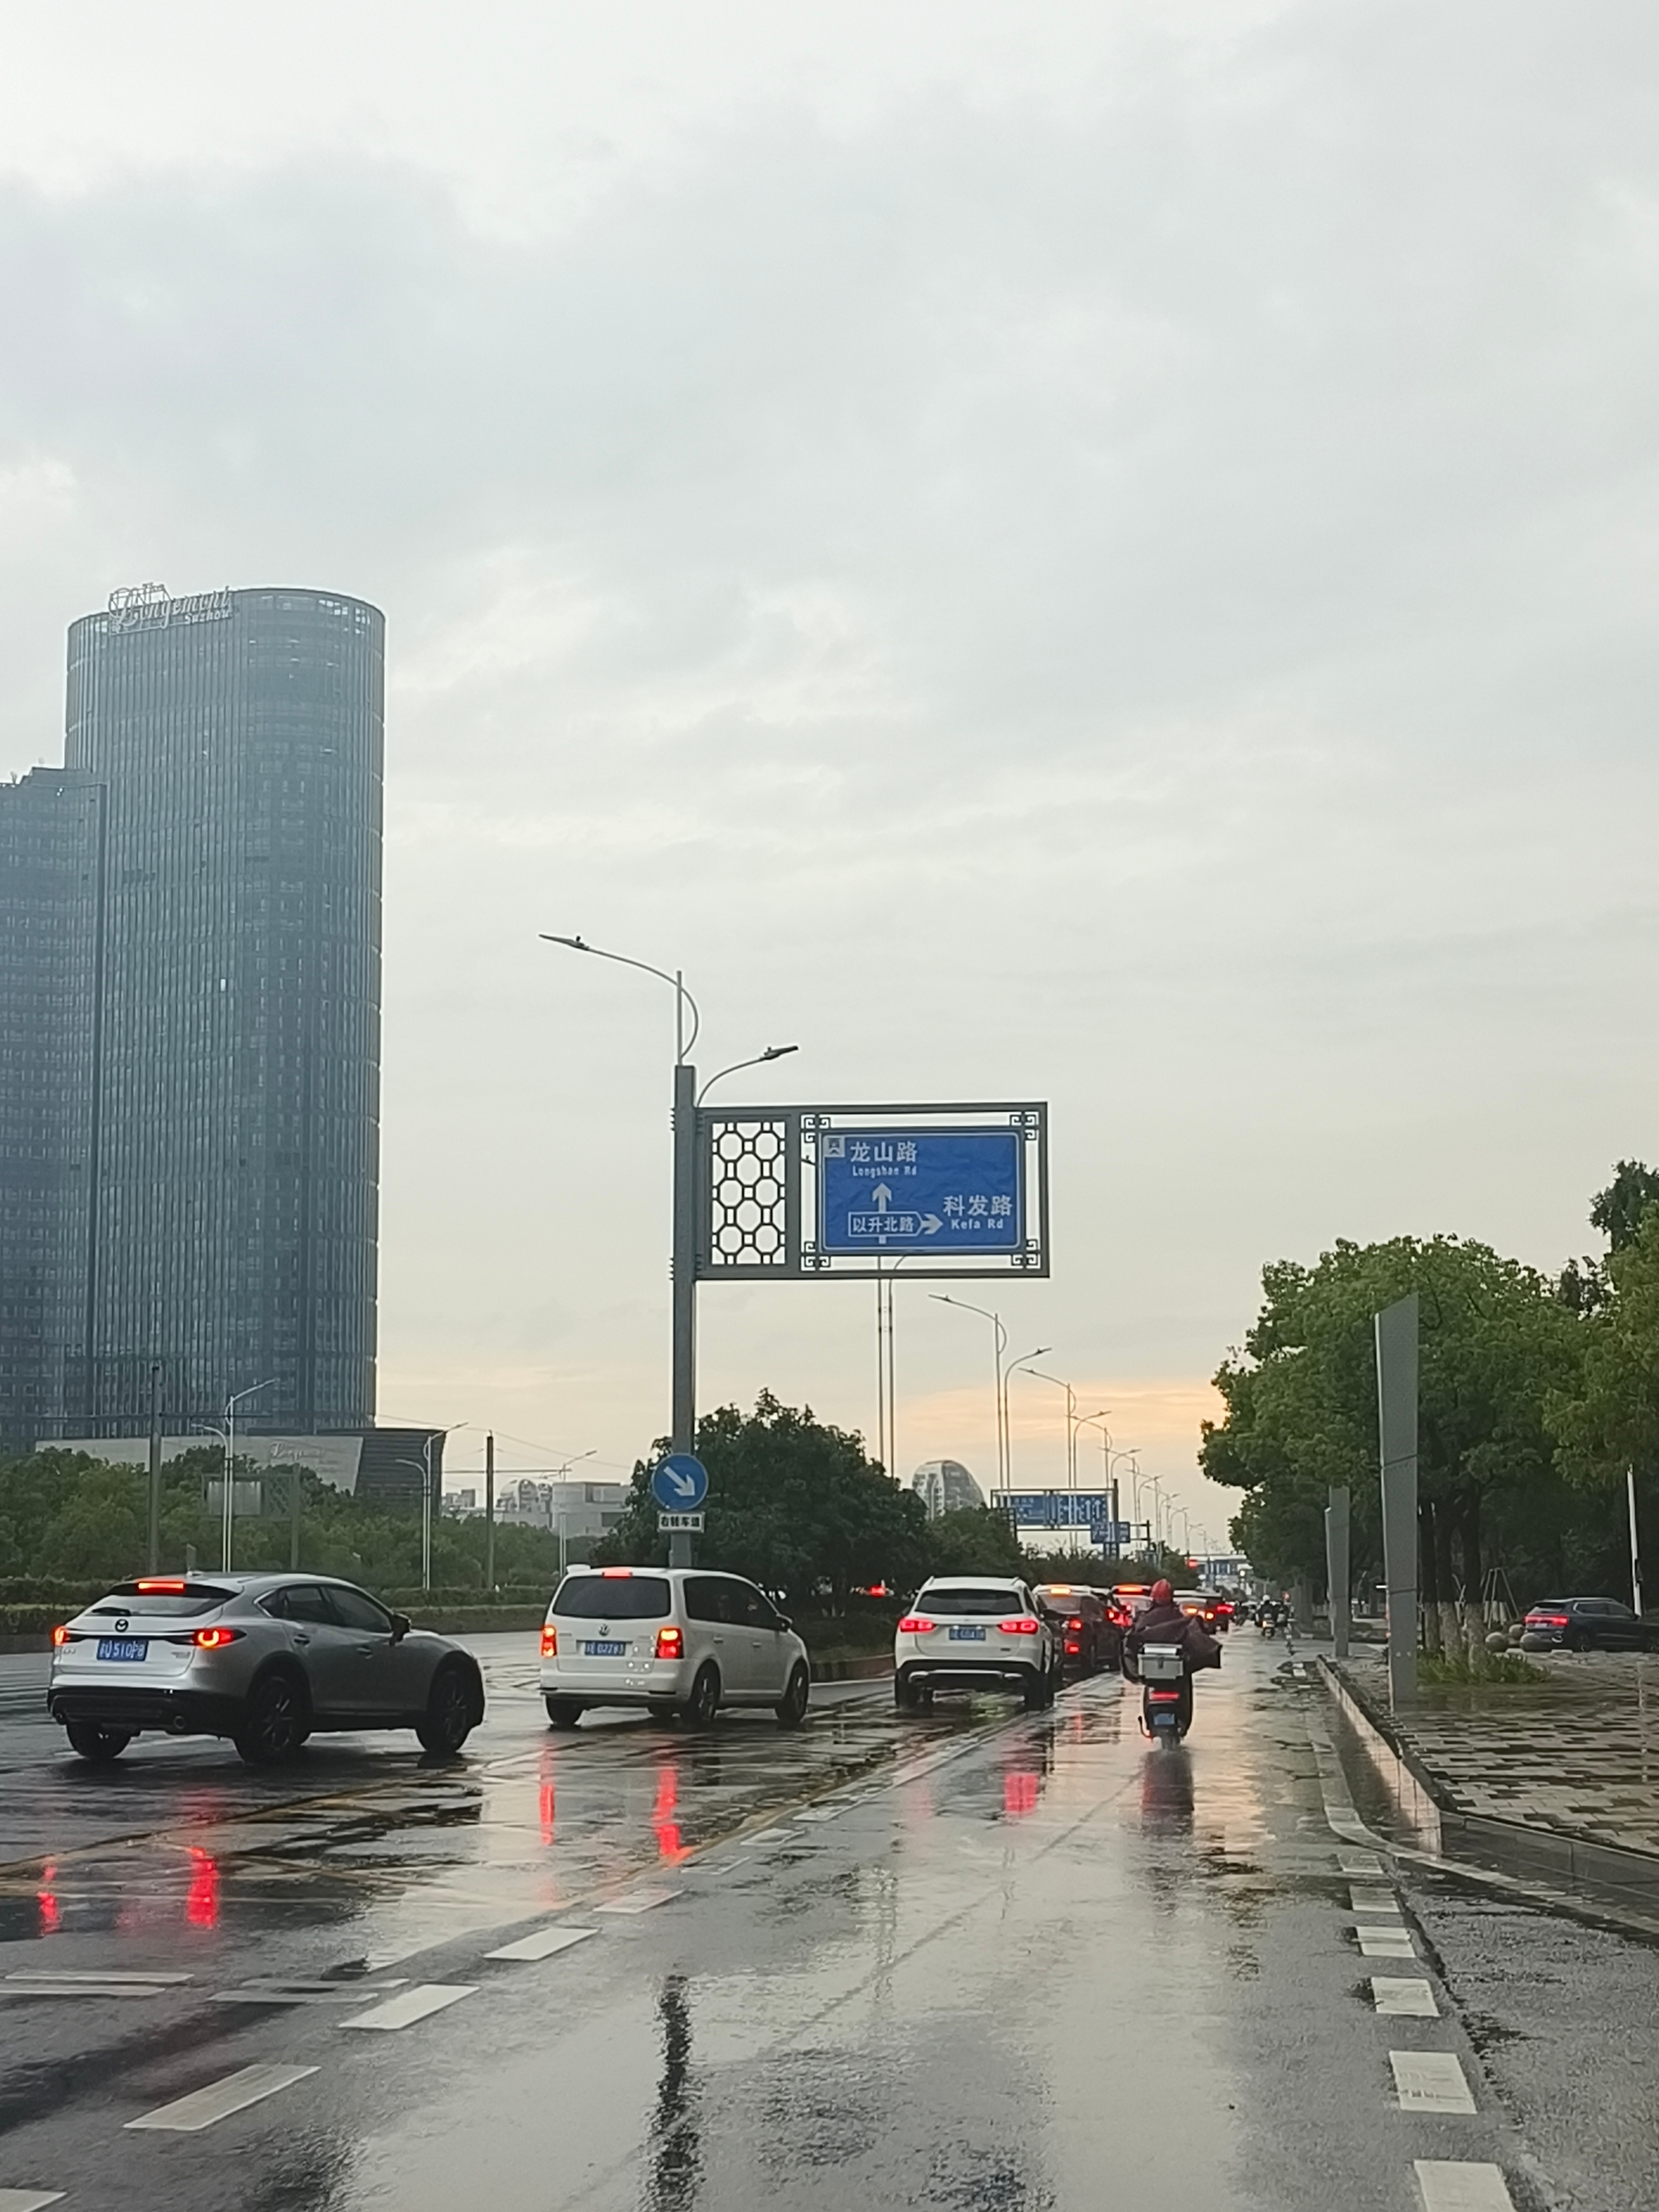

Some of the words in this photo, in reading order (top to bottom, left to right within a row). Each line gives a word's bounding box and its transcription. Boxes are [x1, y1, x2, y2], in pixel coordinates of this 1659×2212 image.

[850, 1141, 918, 1162] 龙山路
[852, 1165, 899, 1179] Longshan
[904, 1165, 917, 1176] Rd
[943, 1195, 1013, 1217] 科发路
[853, 1216, 914, 1233] 以升北路
[951, 1218, 981, 1230] Kefa
[988, 1218, 1003, 1229] Rd
